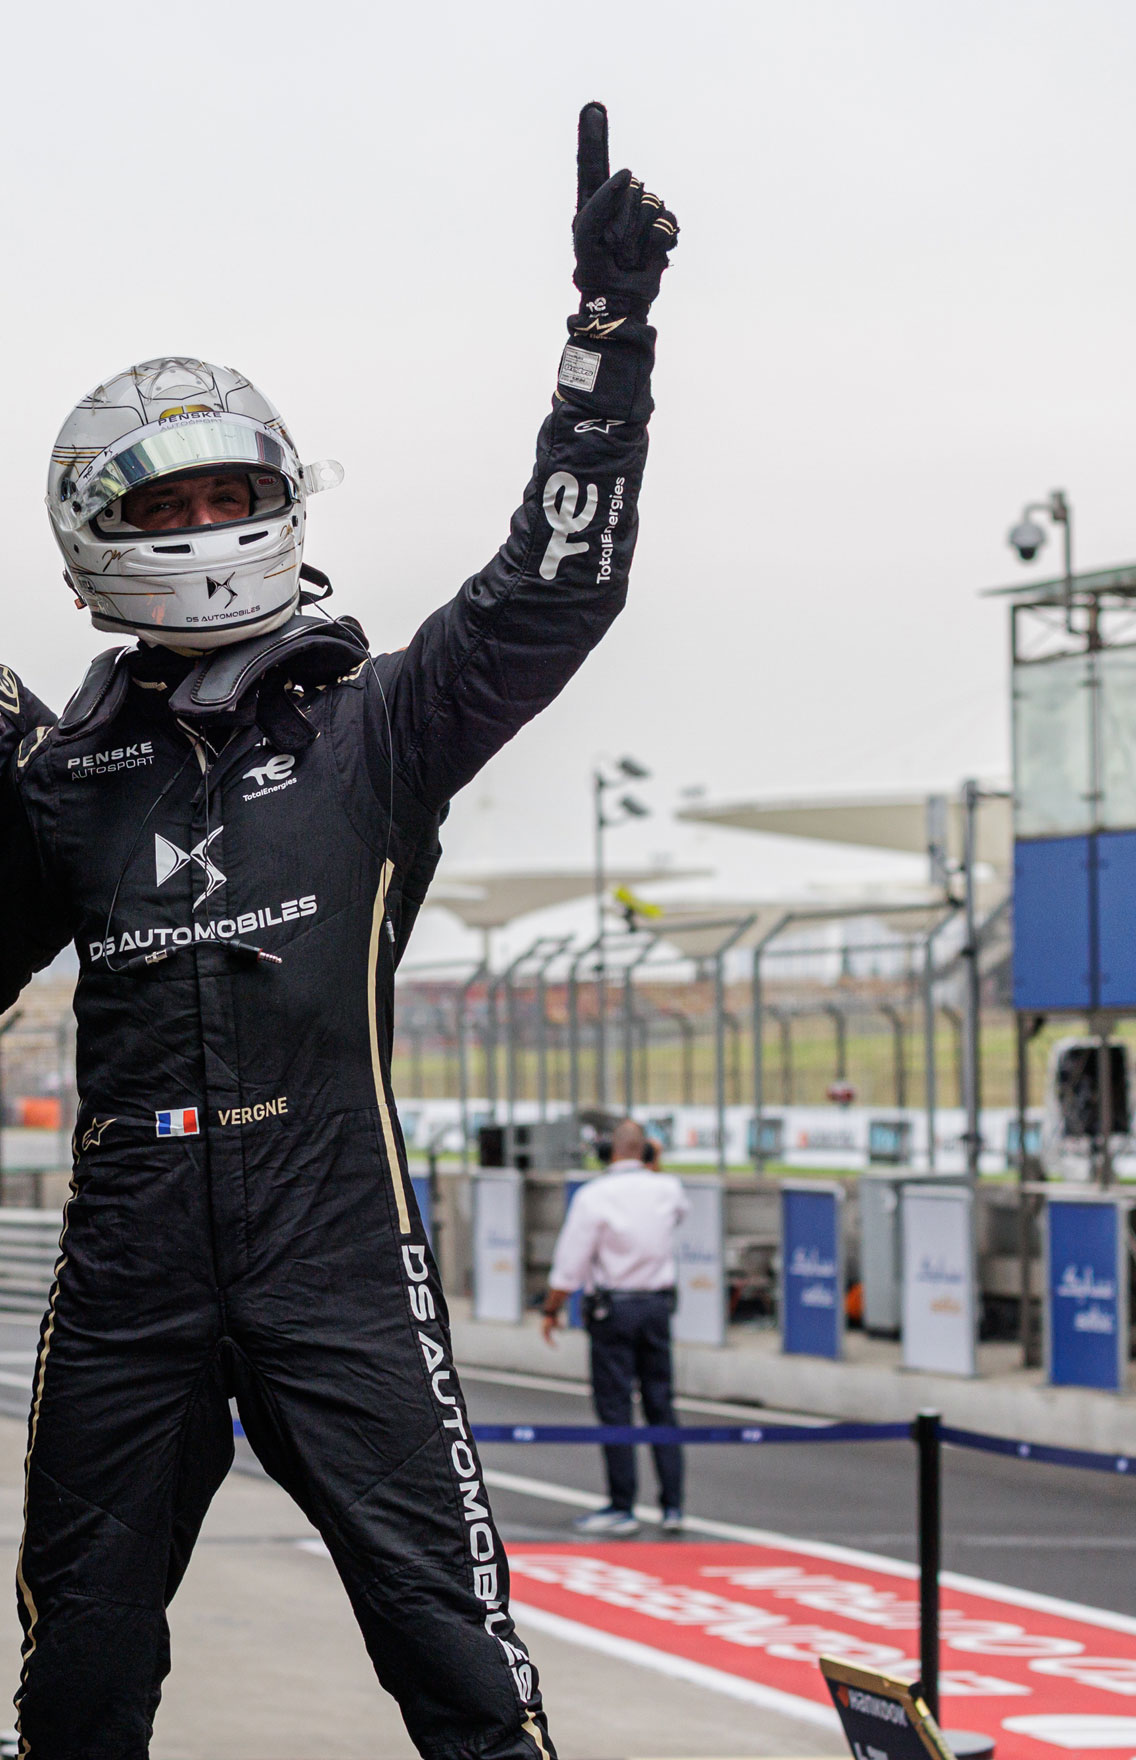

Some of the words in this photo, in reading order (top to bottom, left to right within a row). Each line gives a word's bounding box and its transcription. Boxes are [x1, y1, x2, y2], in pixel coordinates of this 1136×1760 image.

[158, 411, 223, 426] PENSKE
[596, 476, 625, 585] TotalEnergies
[201, 604, 261, 623] AUTOMOBILES
[67, 741, 154, 769] PENSKE
[71, 755, 155, 781] AUTOSPORT
[242, 777, 298, 802] TotalEnergies
[89, 937, 116, 962] DS
[118, 895, 318, 953] AUTOMOBILES
[218, 1096, 288, 1126] VERGNE
[401, 1244, 437, 1322] DS
[417, 1330, 533, 1703] AUTOMOBILES
